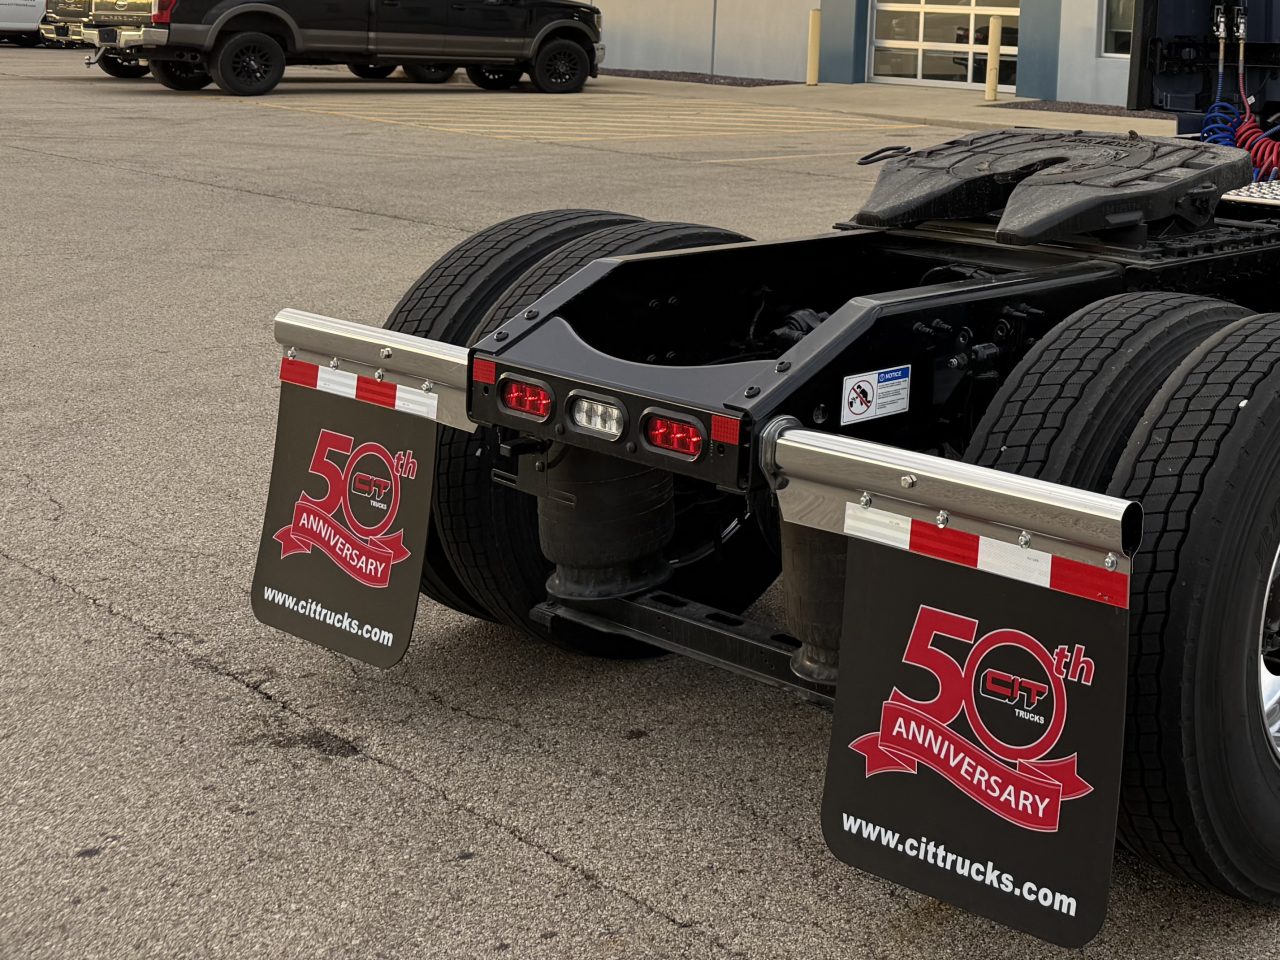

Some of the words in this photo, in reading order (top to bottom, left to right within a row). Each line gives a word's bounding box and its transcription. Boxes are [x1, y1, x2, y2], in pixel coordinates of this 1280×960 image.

[352, 471, 392, 499] CIT
[369, 499, 388, 511] TRUCKS
[298, 512, 386, 578] ANNIVERSARY
[263, 586, 394, 648] www.cittrucks.com
[979, 667, 1049, 710] CIT
[1013, 708, 1046, 725] TRUCKS
[891, 716, 1050, 819] ANNIVERSARY
[841, 813, 1078, 918] www.cittrucks.com
